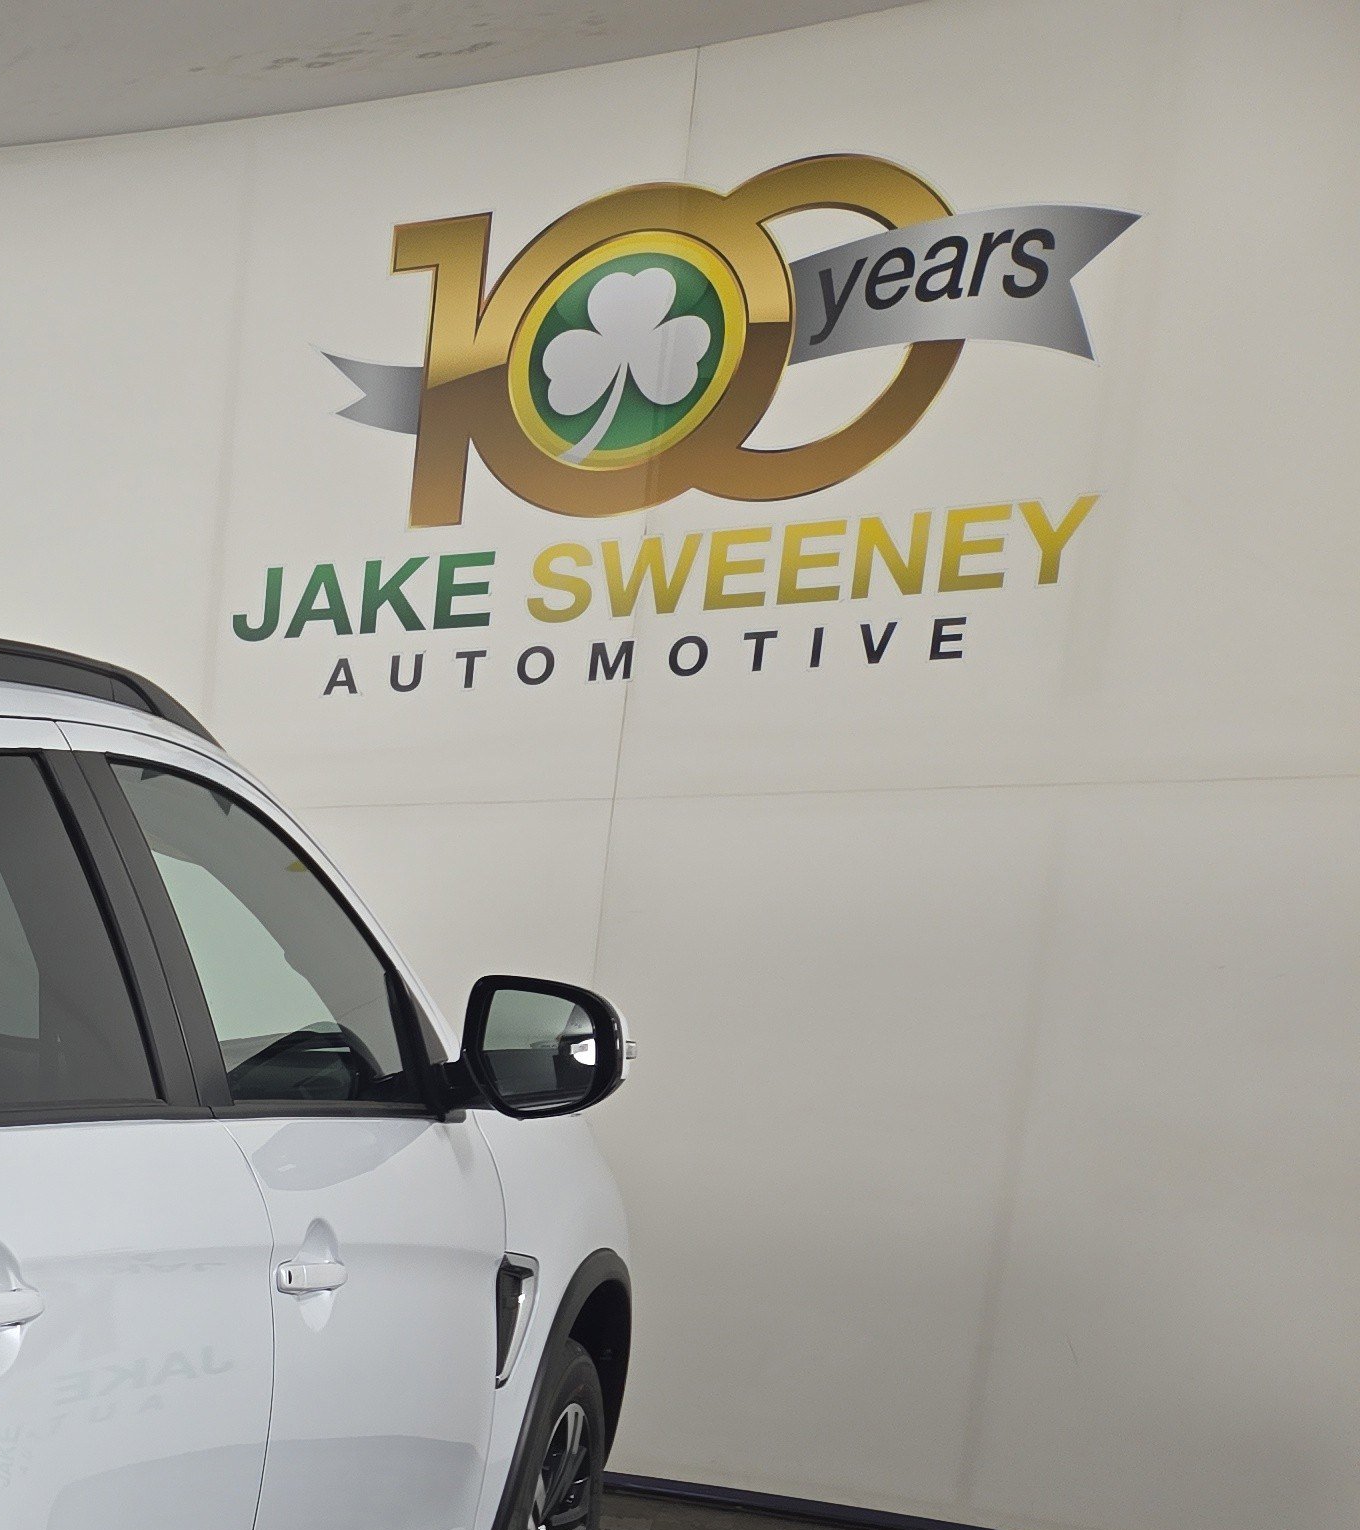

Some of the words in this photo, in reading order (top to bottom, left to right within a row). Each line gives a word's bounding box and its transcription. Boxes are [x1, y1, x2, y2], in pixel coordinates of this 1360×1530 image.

[809, 227, 1055, 346] years
[232, 551, 496, 642] JAKE
[526, 494, 1100, 623] SWEENEY
[323, 615, 968, 697] AUTOMOTIVE
